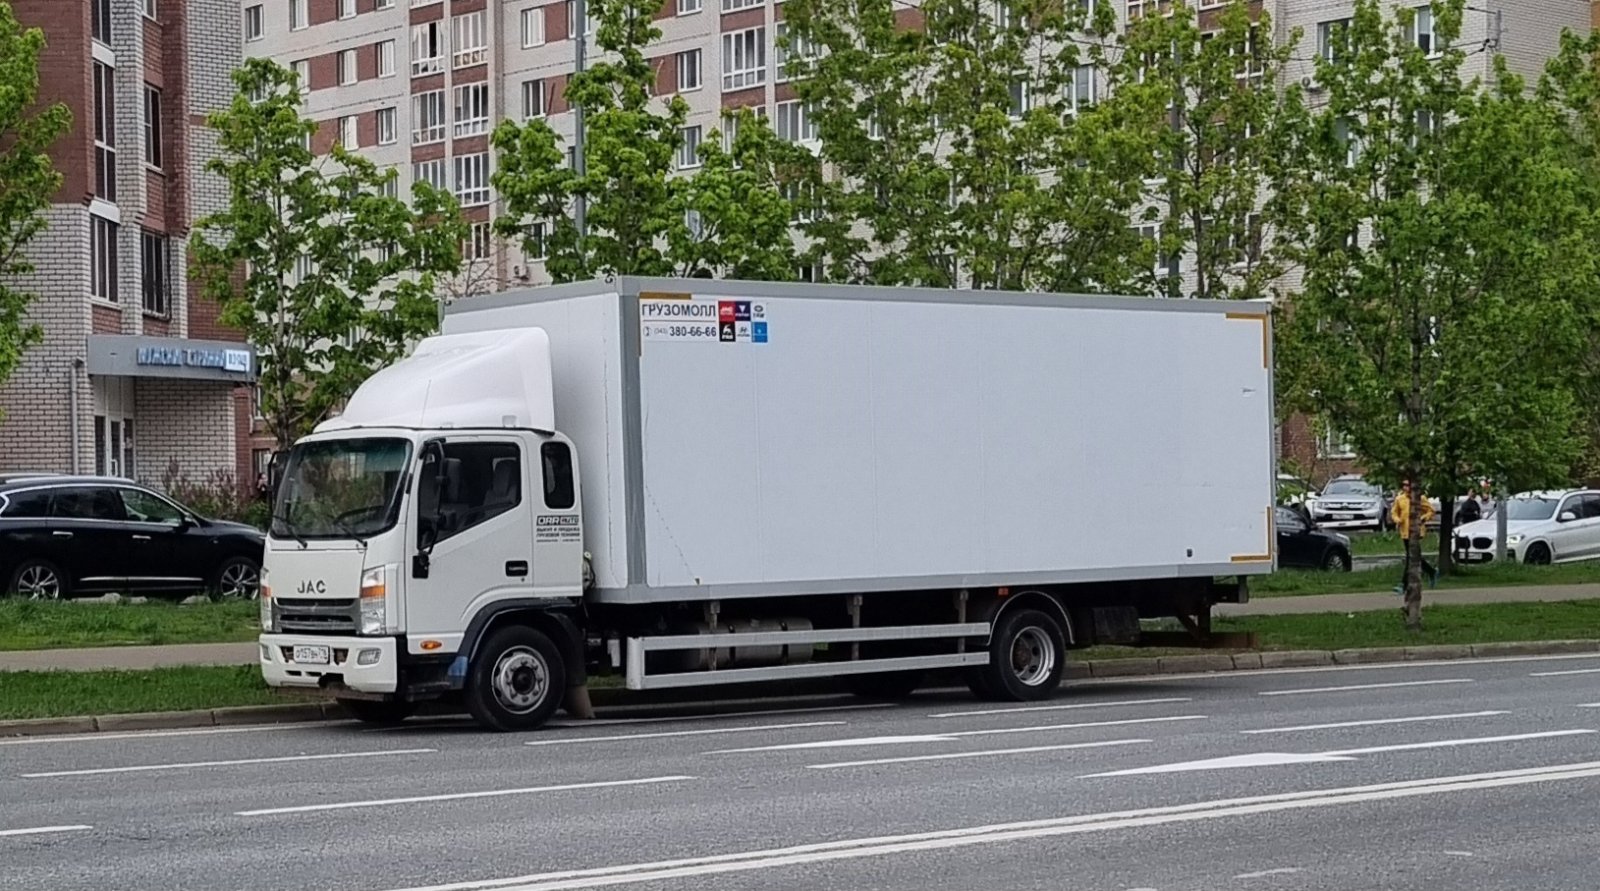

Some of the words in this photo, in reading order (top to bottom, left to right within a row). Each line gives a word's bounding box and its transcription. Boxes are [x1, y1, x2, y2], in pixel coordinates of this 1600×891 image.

[641, 303, 716, 317] ГРУЗОМОЛЛ
[669, 326, 717, 337] 380-66-66
[297, 580, 326, 594] JAC
